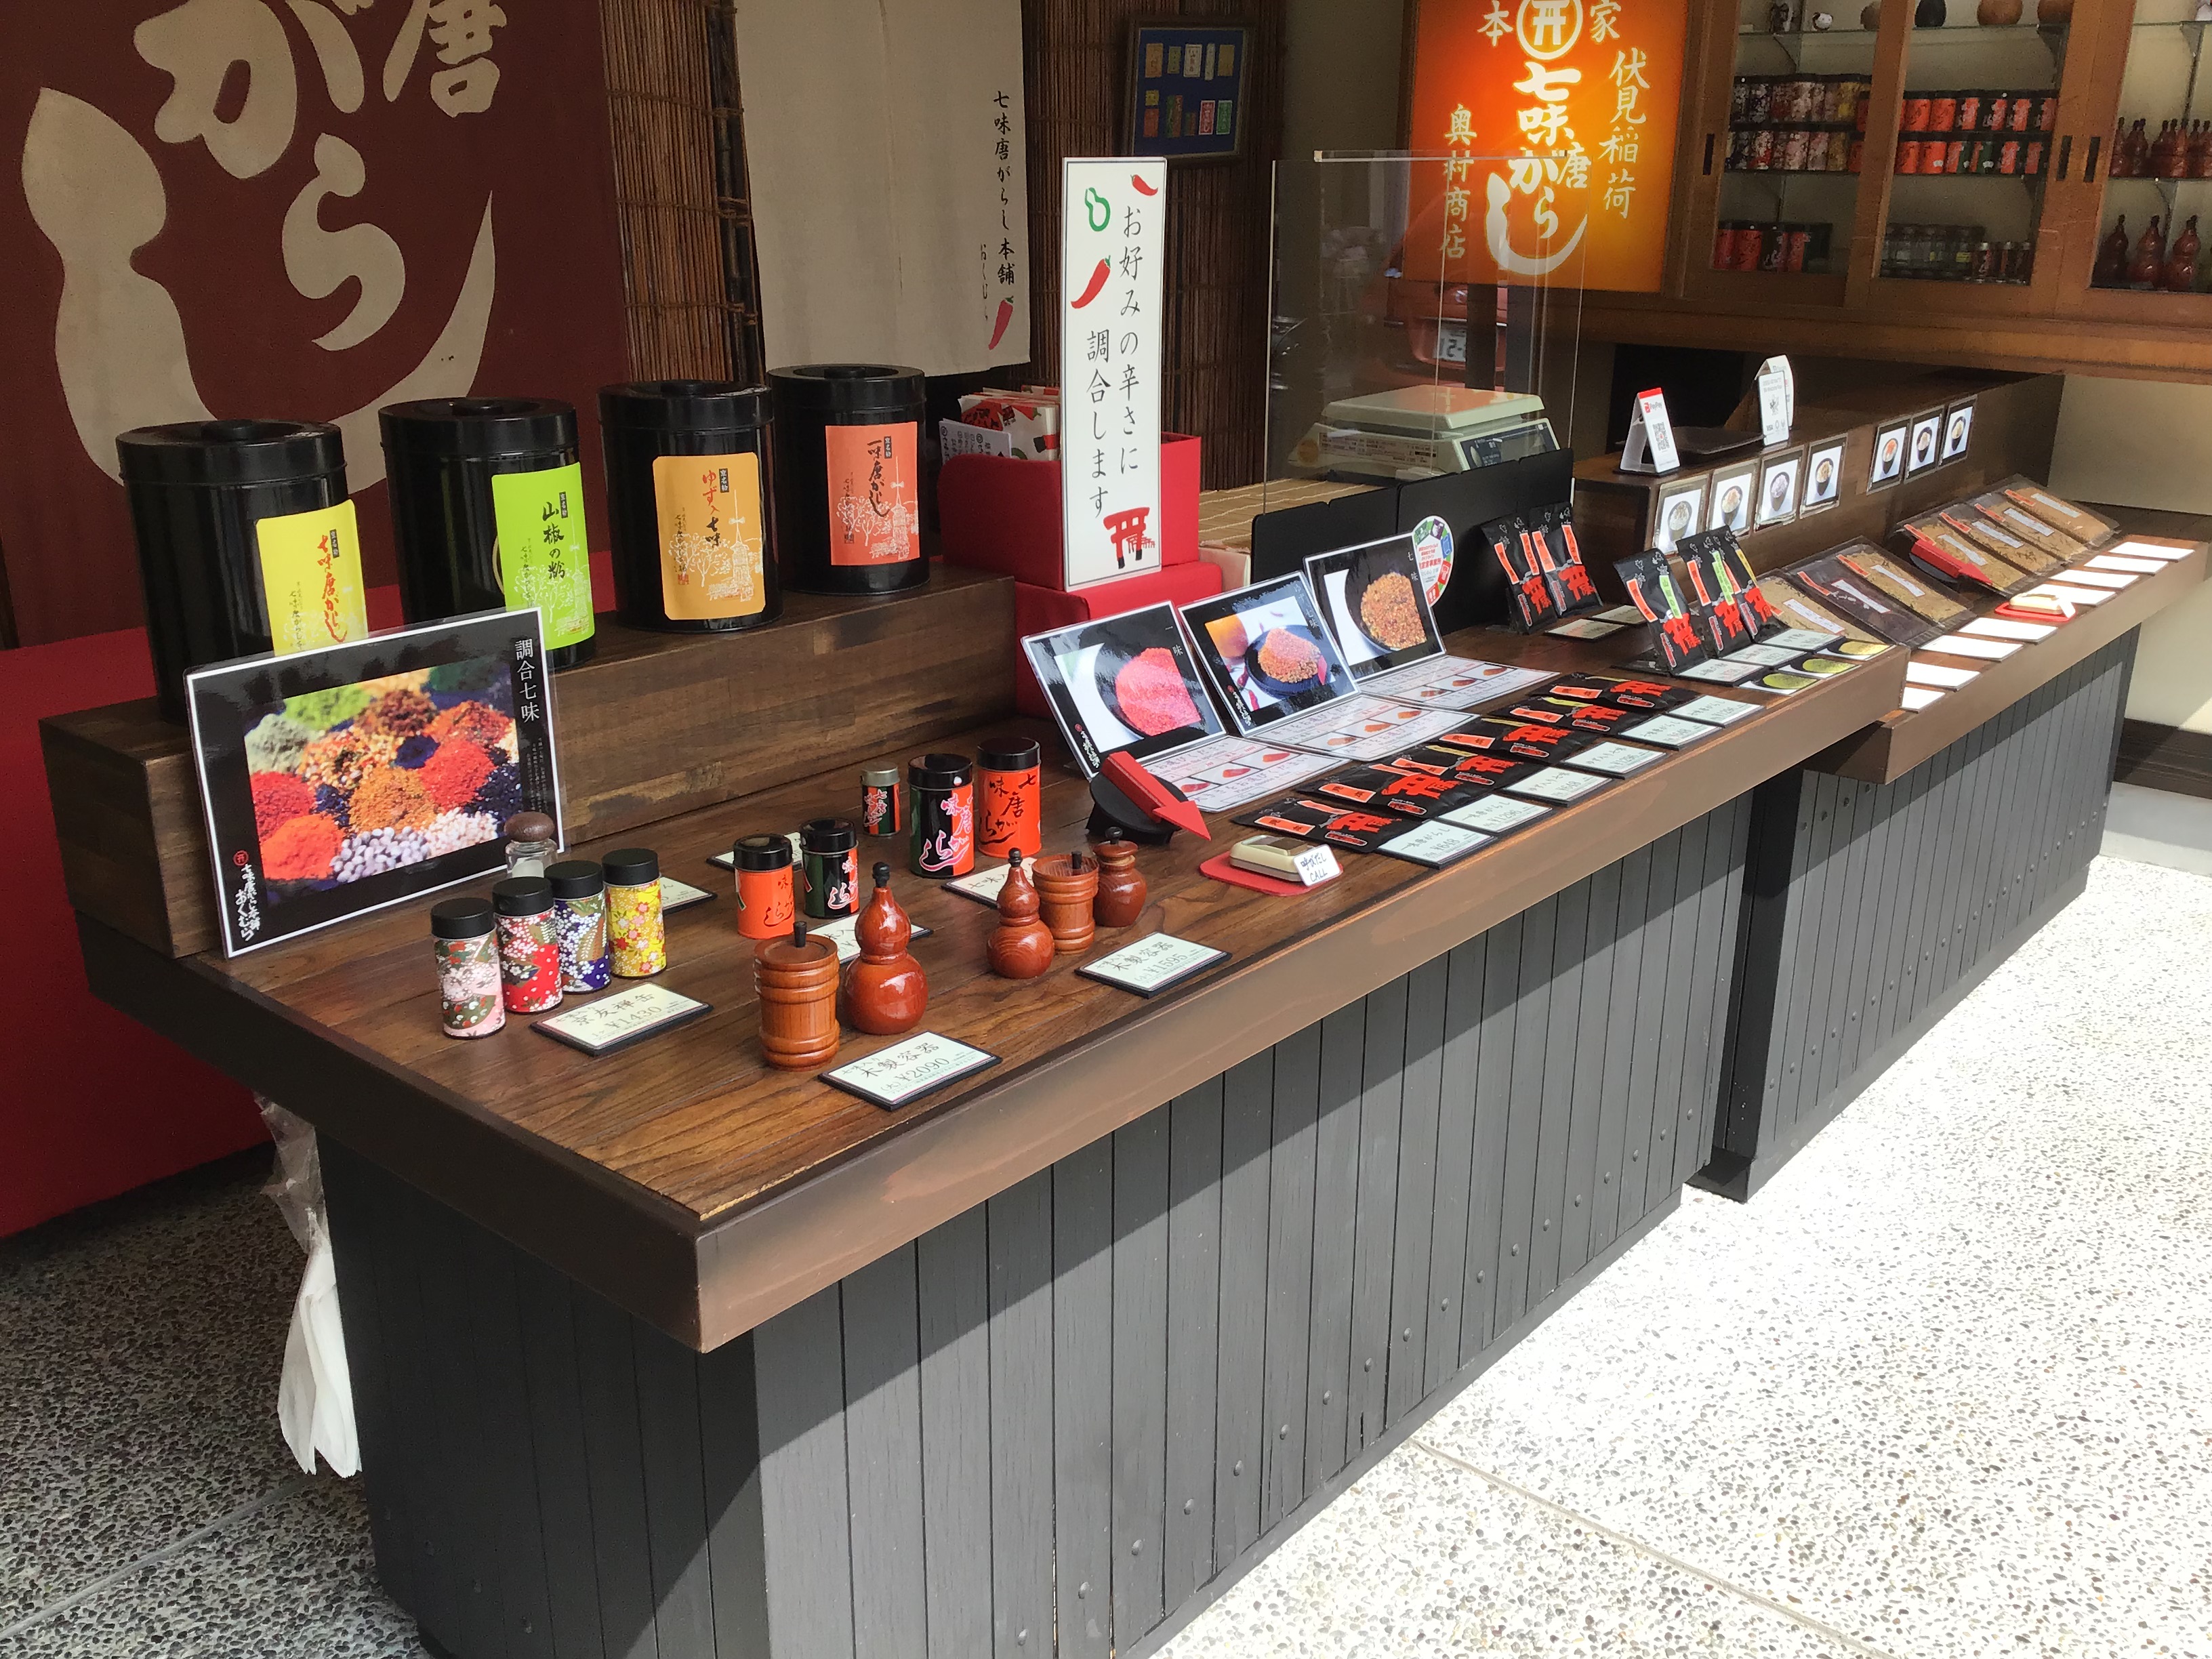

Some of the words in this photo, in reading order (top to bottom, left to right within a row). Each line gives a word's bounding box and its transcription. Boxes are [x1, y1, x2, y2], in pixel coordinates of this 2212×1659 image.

[1598, 47, 1650, 219] 伏見稲荷
[993, 90, 1015, 285] 七味唐がらし本舗
[1439, 103, 1478, 260] 奥村商店
[1118, 205, 1144, 475] お好みの辛さに
[1086, 328, 1112, 518] 調合します
[542, 501, 565, 579] 山椒の粉
[514, 638, 540, 723] 調合七味
[1309, 868, 1329, 883] CALL
[1111, 941, 1174, 972] 木製容器
[1143, 953, 1189, 975] ¥1595
[605, 1006, 662, 1029] ¥1430
[861, 1042, 940, 1079] 木製容器
[895, 1057, 949, 1082] ¥2090
